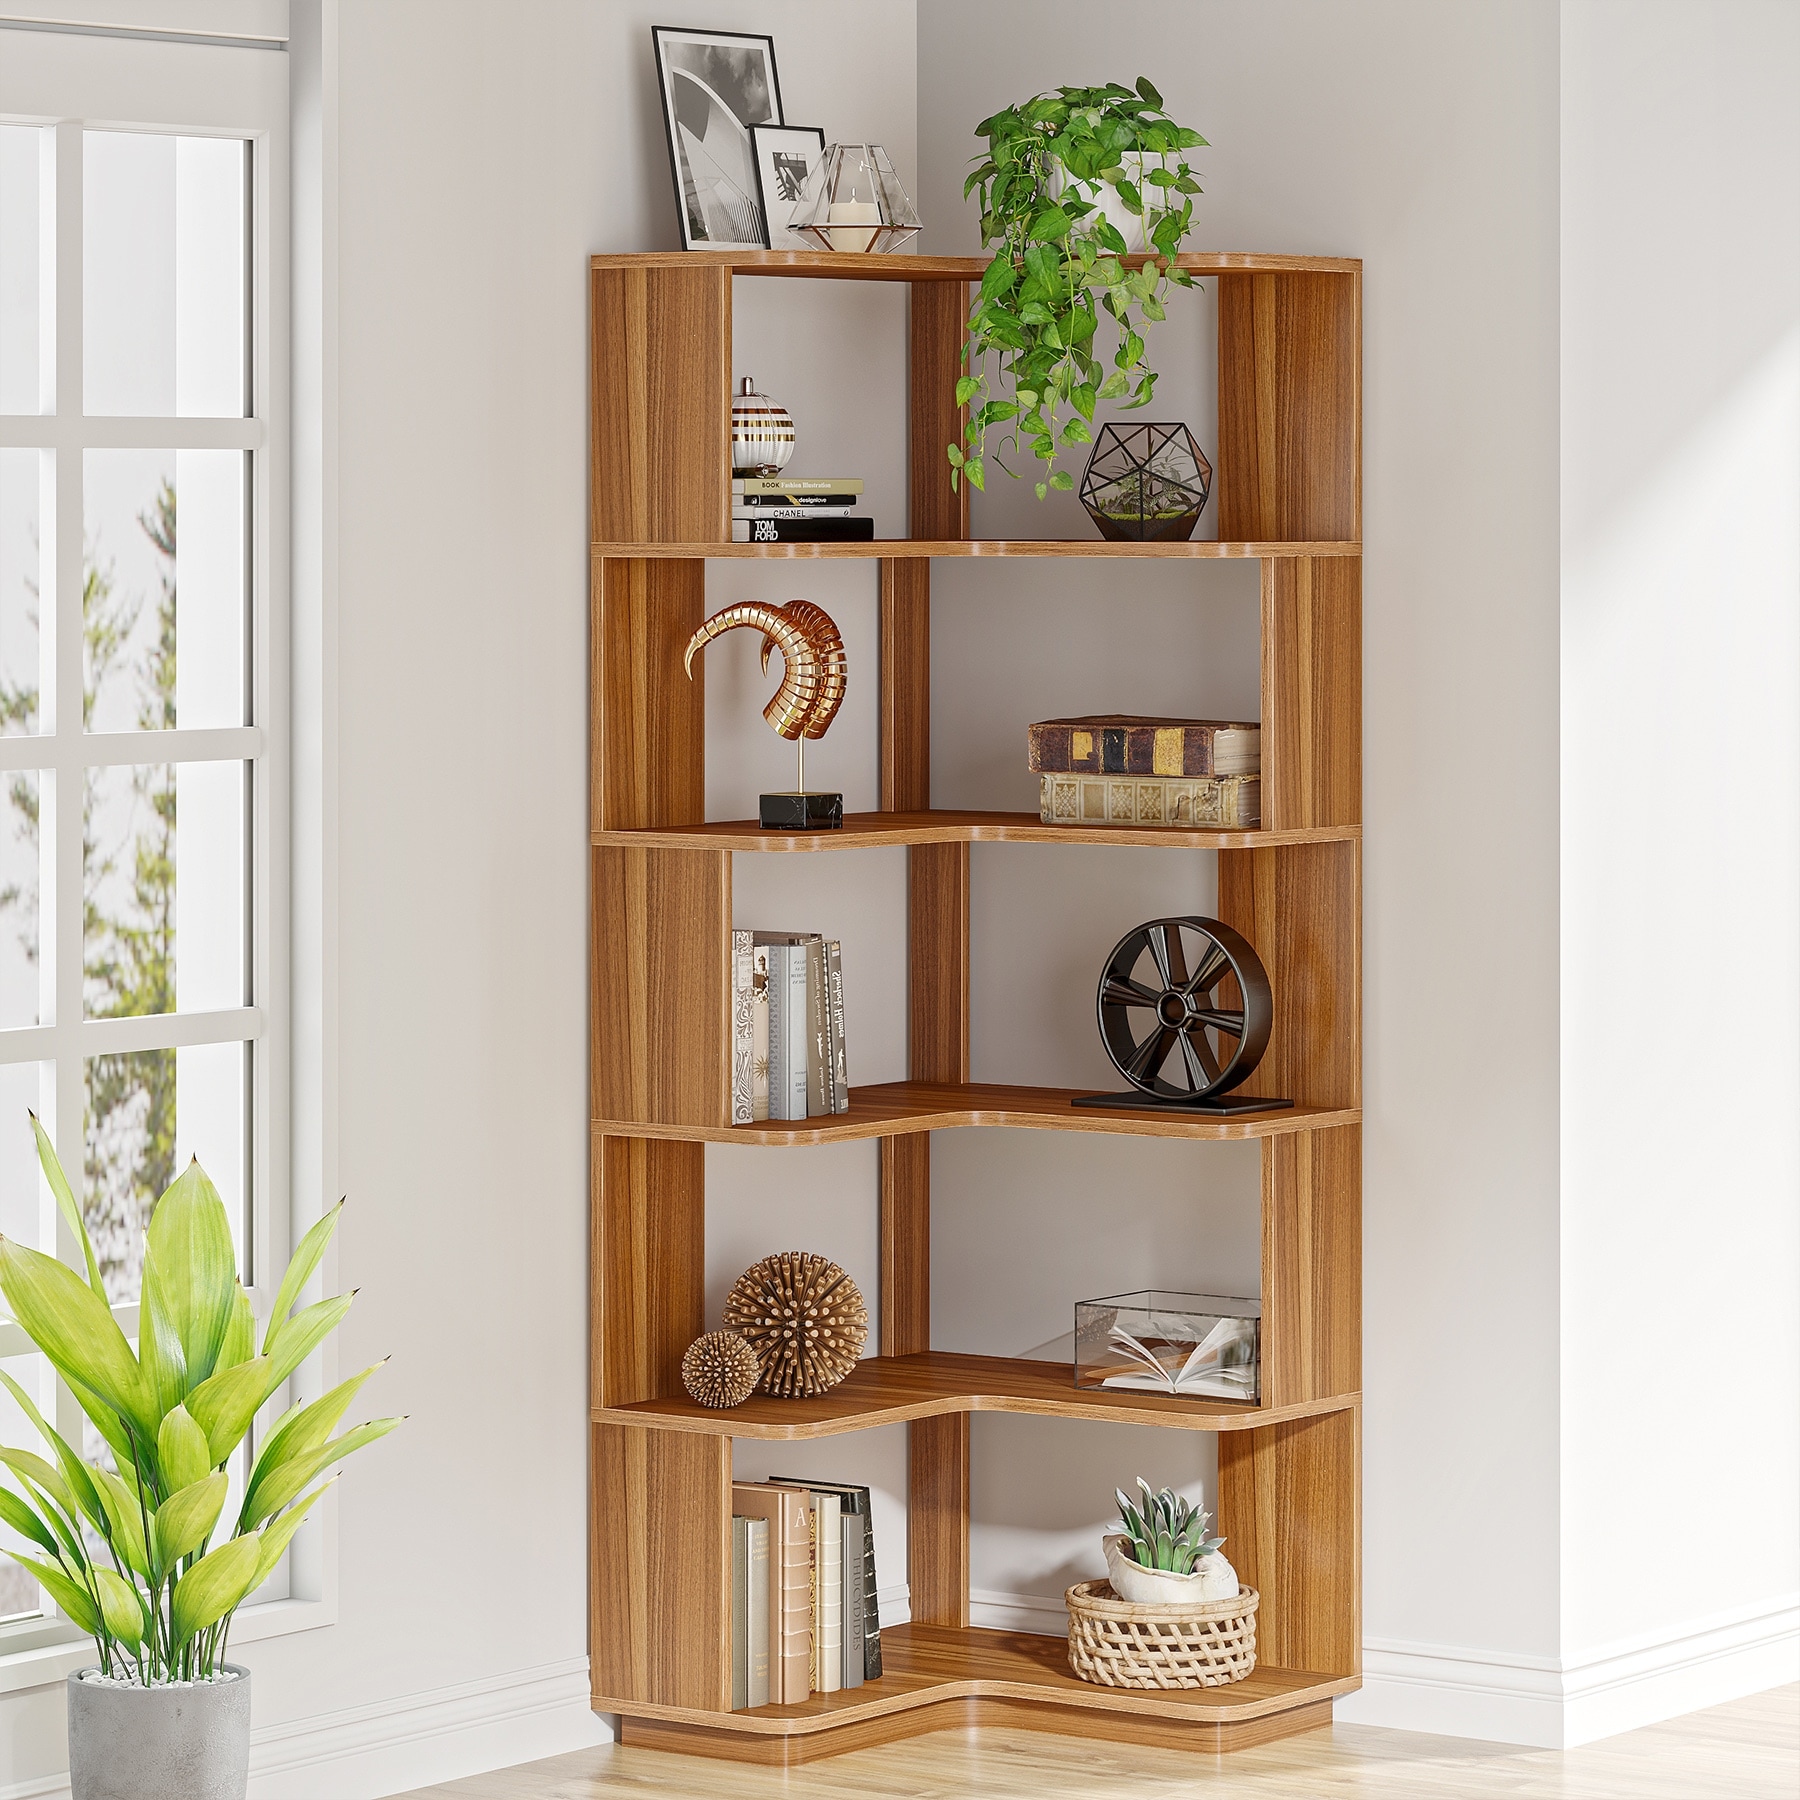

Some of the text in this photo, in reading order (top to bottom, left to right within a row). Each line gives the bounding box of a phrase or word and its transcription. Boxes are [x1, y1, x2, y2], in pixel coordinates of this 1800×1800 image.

[755, 520, 774, 530] TOM
[755, 531, 778, 541] FORD
[794, 1507, 806, 1528] A
[853, 1553, 861, 1651] THUCYDIDES
